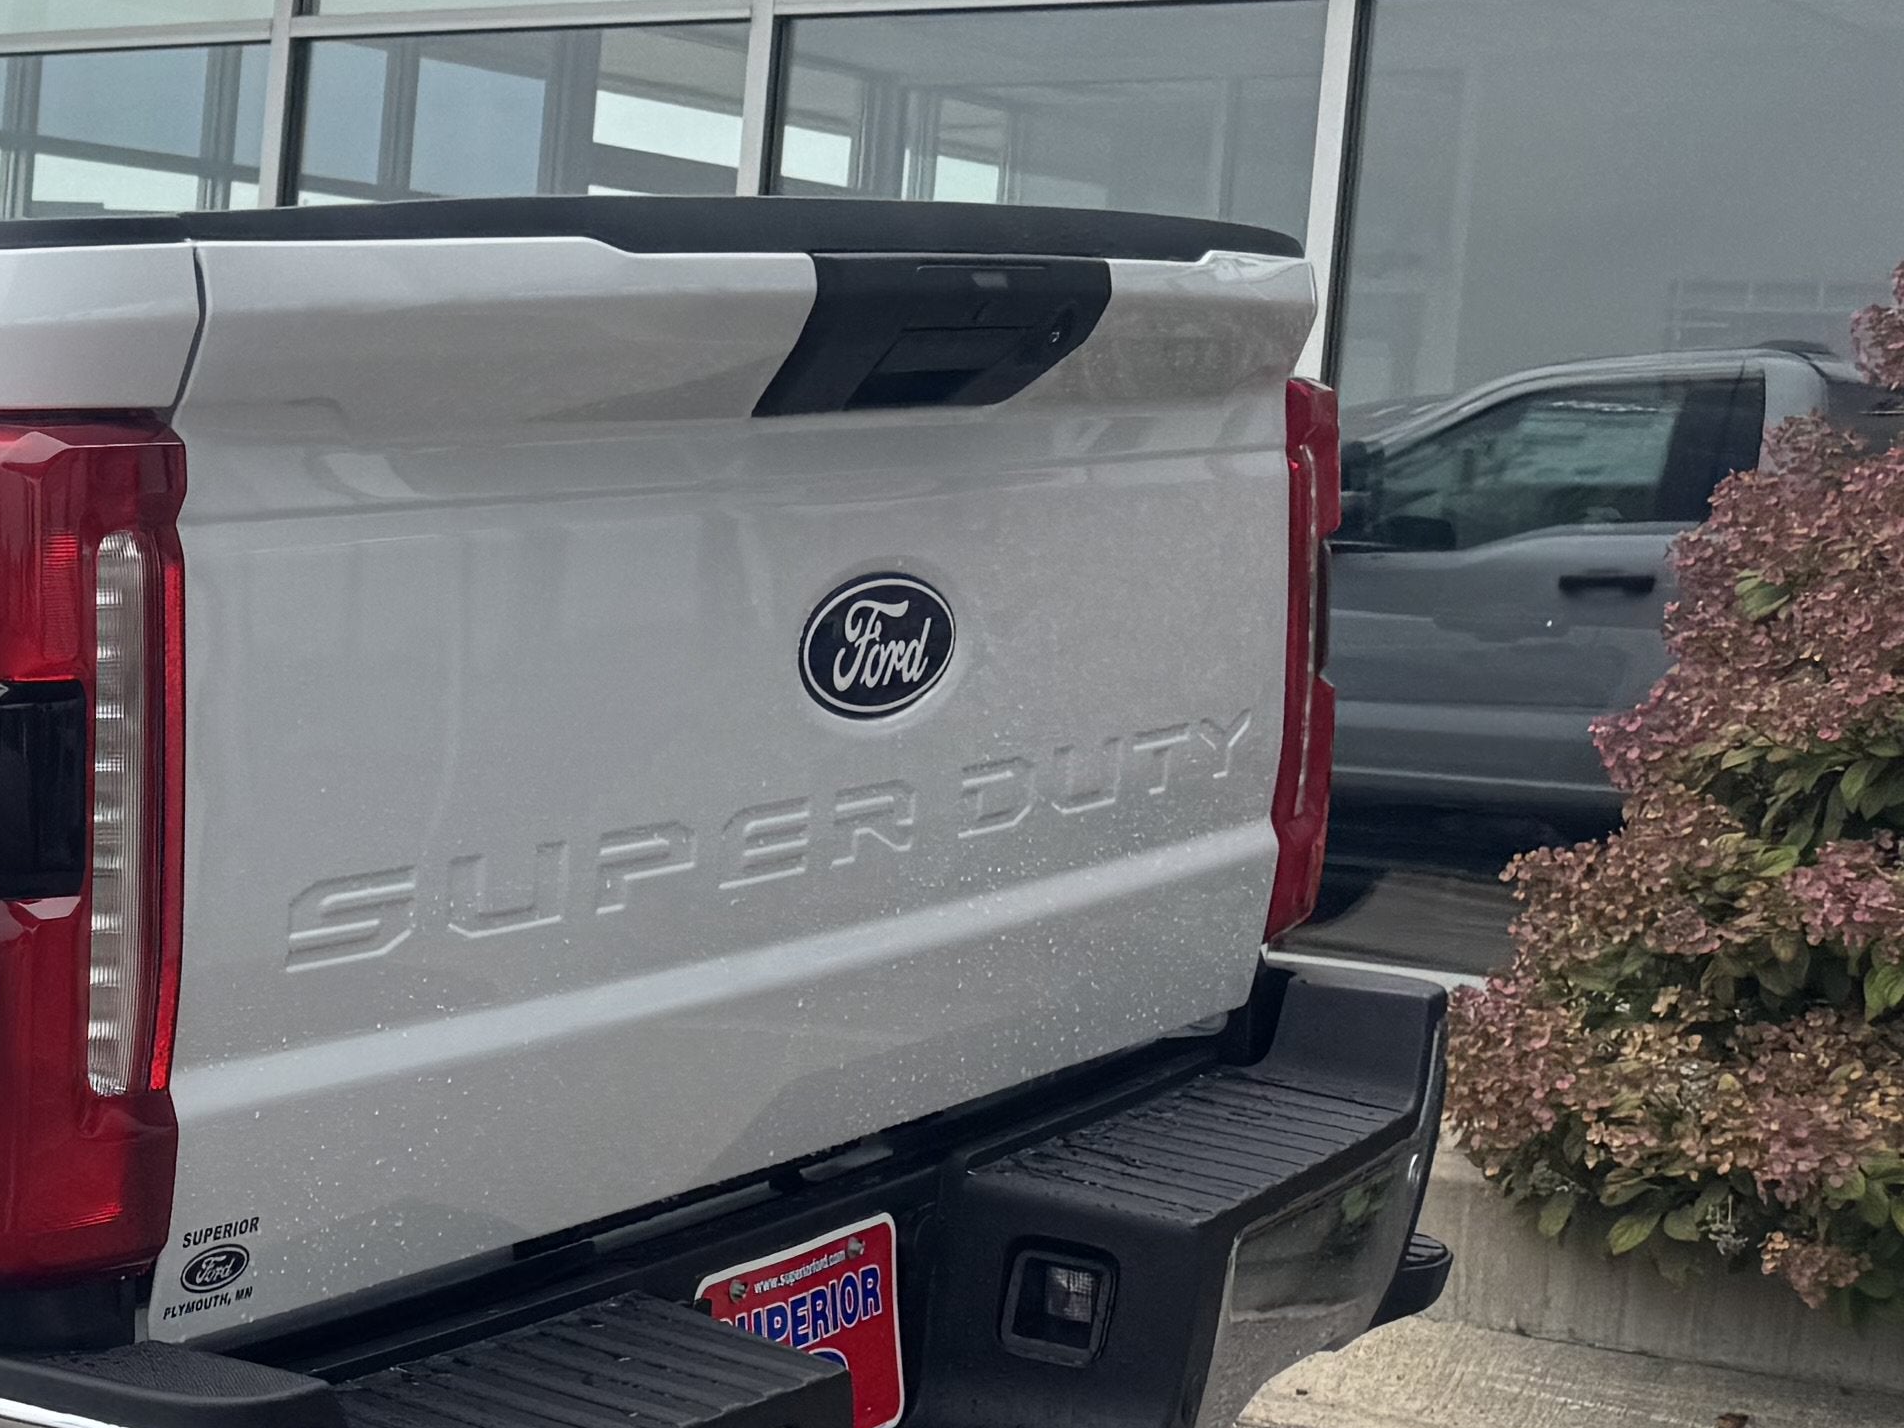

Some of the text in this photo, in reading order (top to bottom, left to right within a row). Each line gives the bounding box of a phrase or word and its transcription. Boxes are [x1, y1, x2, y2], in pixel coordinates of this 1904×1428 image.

[832, 599, 933, 692] Ford
[287, 707, 1252, 972] SUPER DUTY
[182, 1216, 260, 1249] SUPERIOR
[163, 1285, 253, 1321] PLYMOUTH, MN
[719, 1264, 883, 1351] UPERIOR
